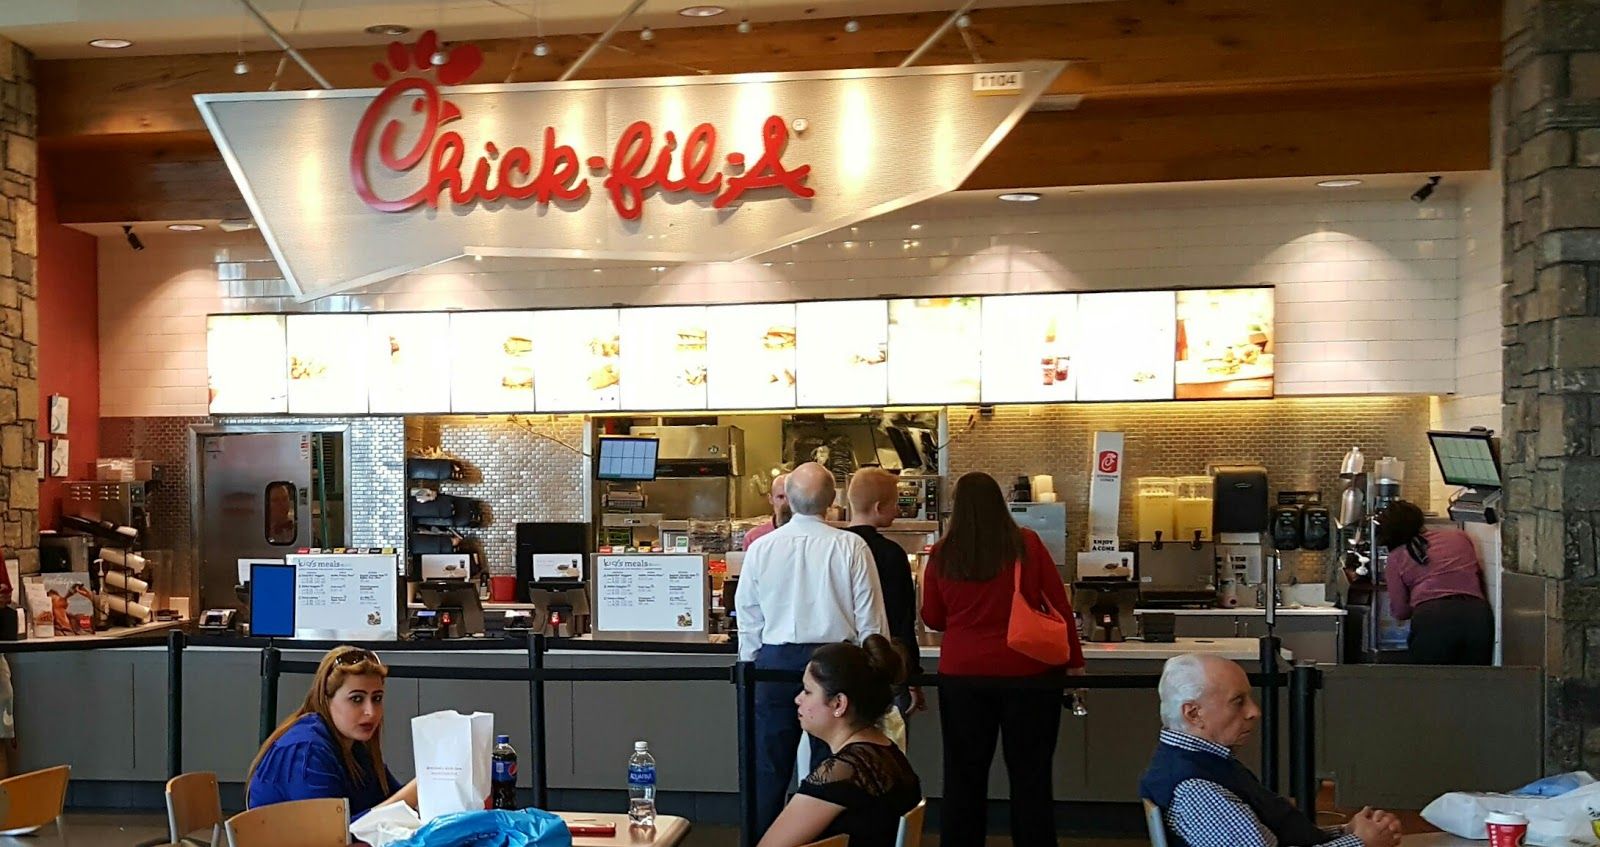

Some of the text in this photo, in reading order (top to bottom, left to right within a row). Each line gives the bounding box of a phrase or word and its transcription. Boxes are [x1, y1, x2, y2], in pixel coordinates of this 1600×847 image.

[979, 74, 1018, 88] 1104
[350, 70, 815, 220] Chick-fil-A
[317, 559, 341, 568] meals
[624, 558, 648, 568] meals
